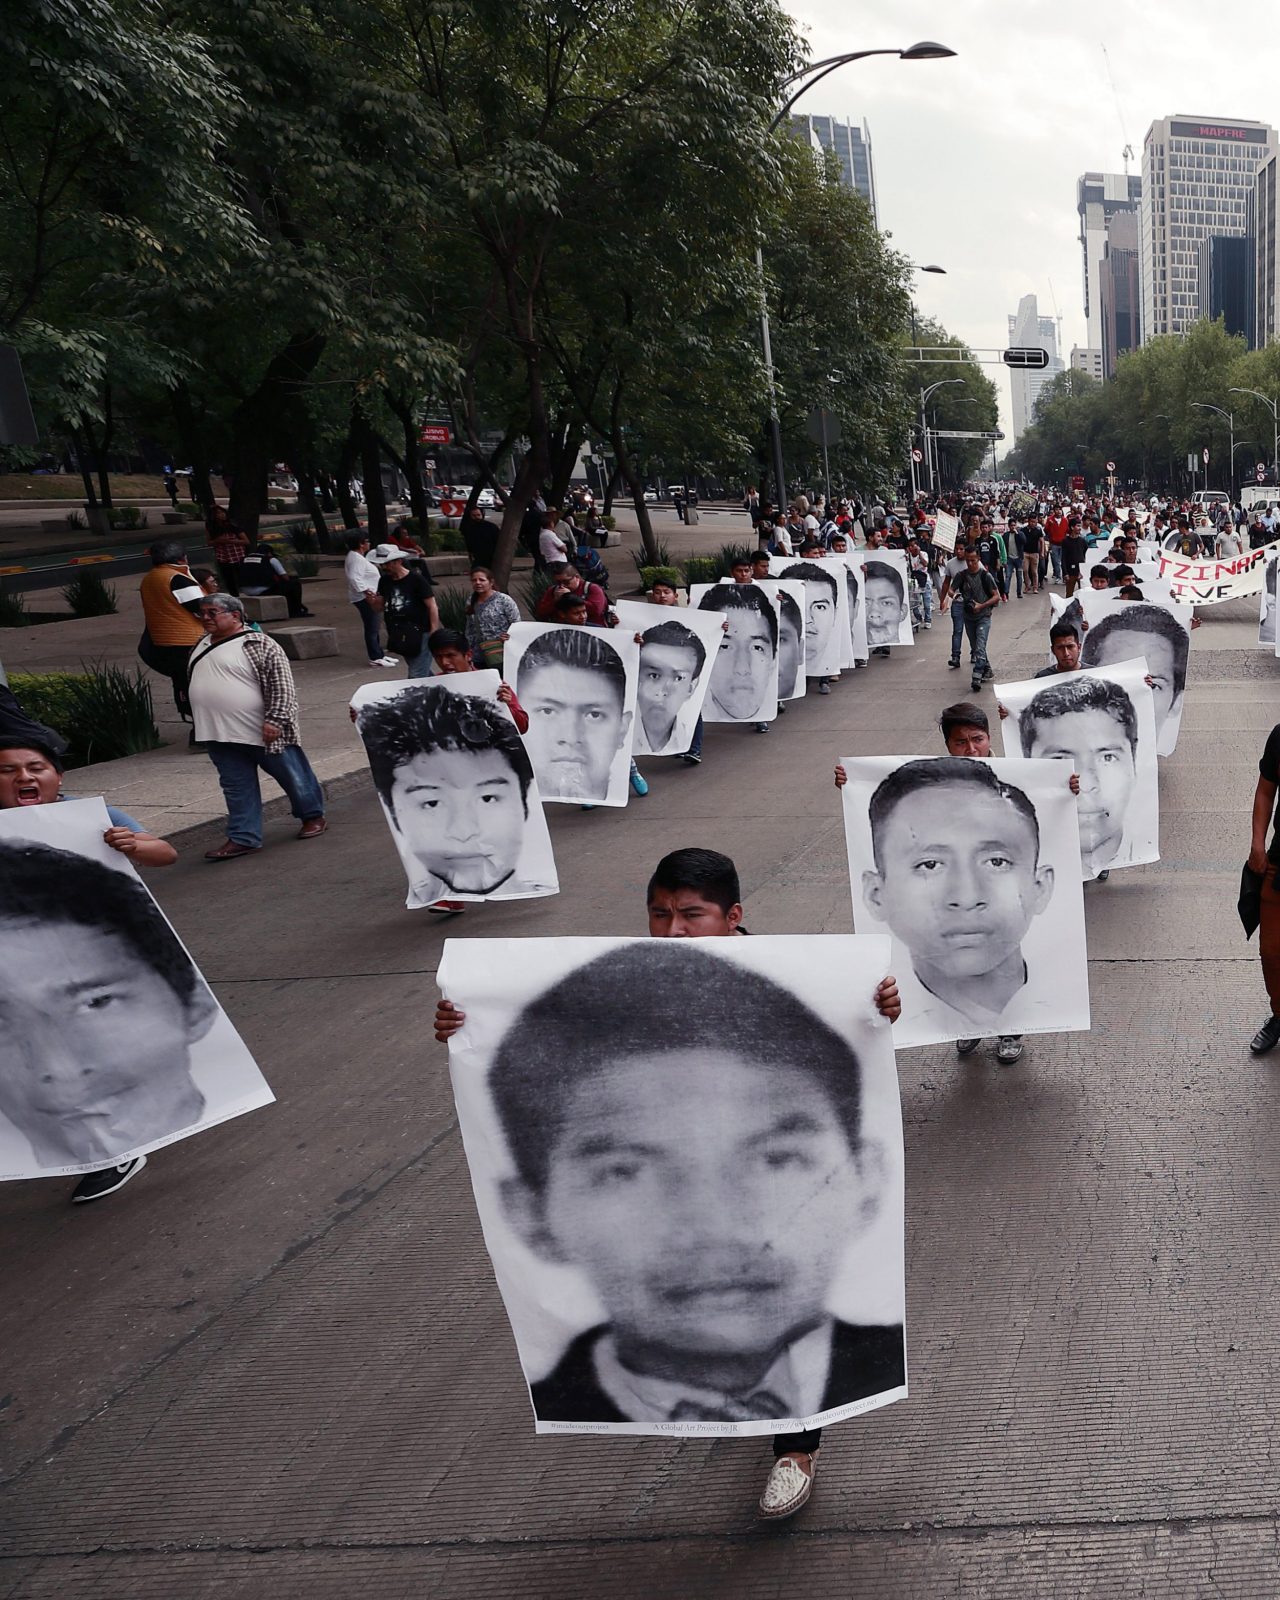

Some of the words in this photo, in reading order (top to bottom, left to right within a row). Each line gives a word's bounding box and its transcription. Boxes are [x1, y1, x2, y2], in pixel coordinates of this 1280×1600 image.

[1199, 127, 1247, 139] MAPFRE
[1160, 546, 1277, 580] TZINAP
[653, 1423, 660, 1431] A
[661, 1423, 682, 1431] Global
[684, 1423, 695, 1431] Art
[697, 1423, 718, 1433] Project
[720, 1423, 728, 1433] by
[729, 1424, 738, 1433] JR
